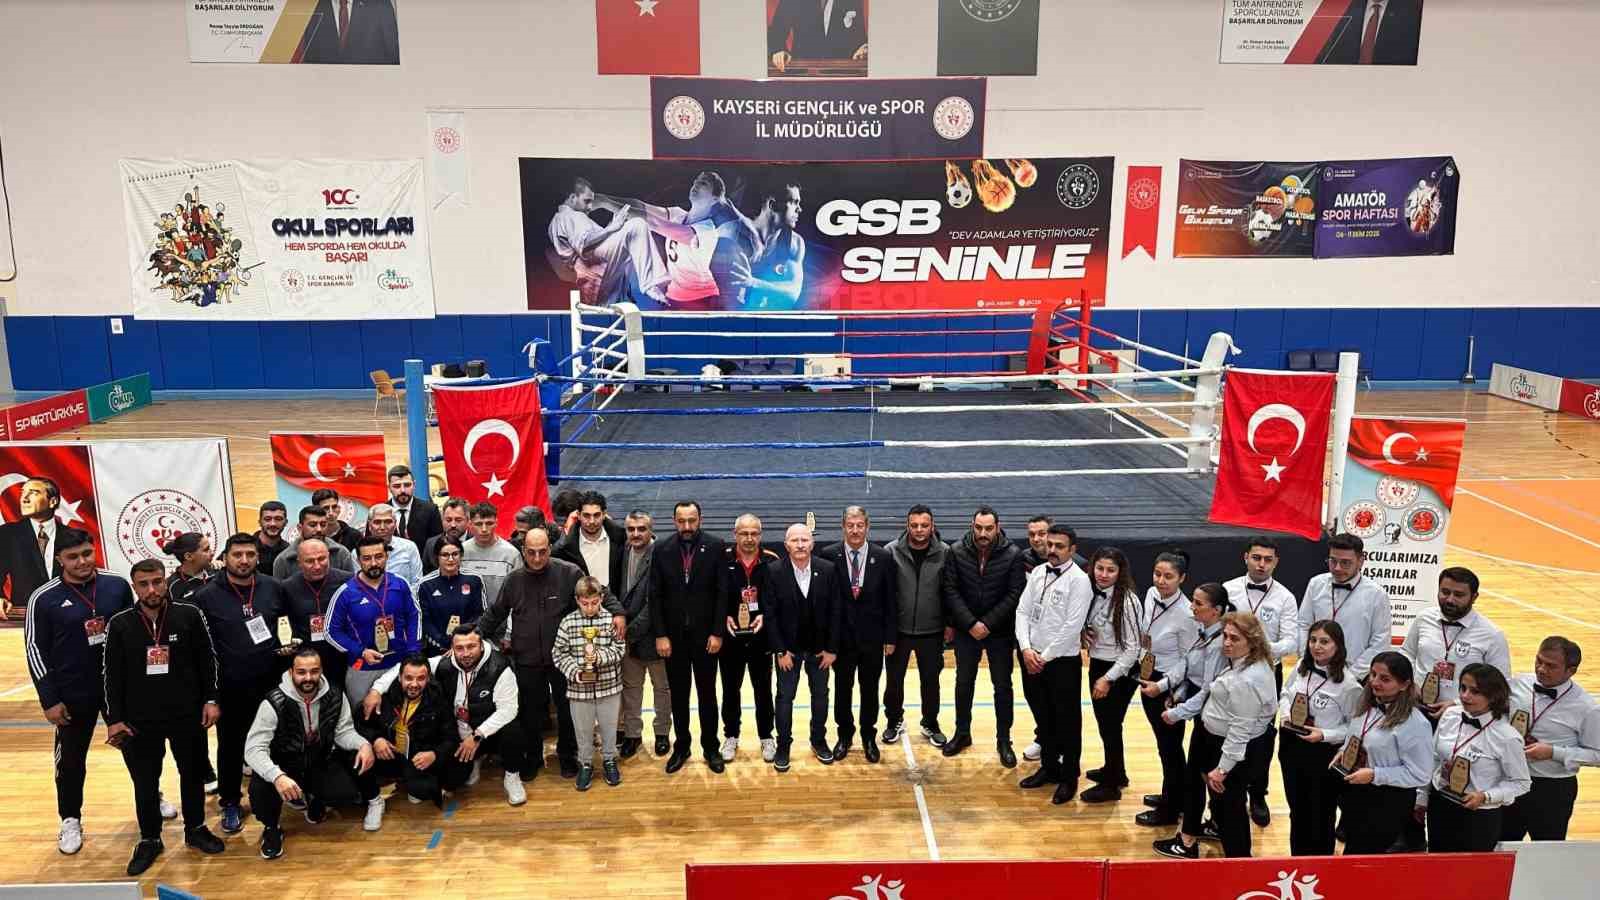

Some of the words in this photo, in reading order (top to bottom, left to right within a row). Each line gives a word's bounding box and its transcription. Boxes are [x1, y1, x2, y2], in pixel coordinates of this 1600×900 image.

[859, 103, 877, 115] ve
[880, 99, 925, 114] SPOR
[755, 120, 770, 138] İL
[774, 119, 882, 138] MÜDÜRLÜĞÜ
[1334, 190, 1386, 208] AMATÖR
[815, 199, 942, 237] GSB
[1322, 209, 1351, 221] SPOR
[1353, 208, 1399, 220] HAFTASI
[271, 218, 324, 237] OKUL
[324, 216, 414, 238] SPORLARI
[973, 230, 1020, 240] ADAMLAR
[284, 242, 306, 251] HEM
[307, 242, 345, 251] SPORDA
[346, 242, 367, 251] HEM
[367, 241, 406, 250] OKULDA
[325, 252, 368, 264] BAŞARI
[1362, 551, 1438, 565] RCULARIMIZA
[1360, 567, 1418, 580] AŞARILAR
